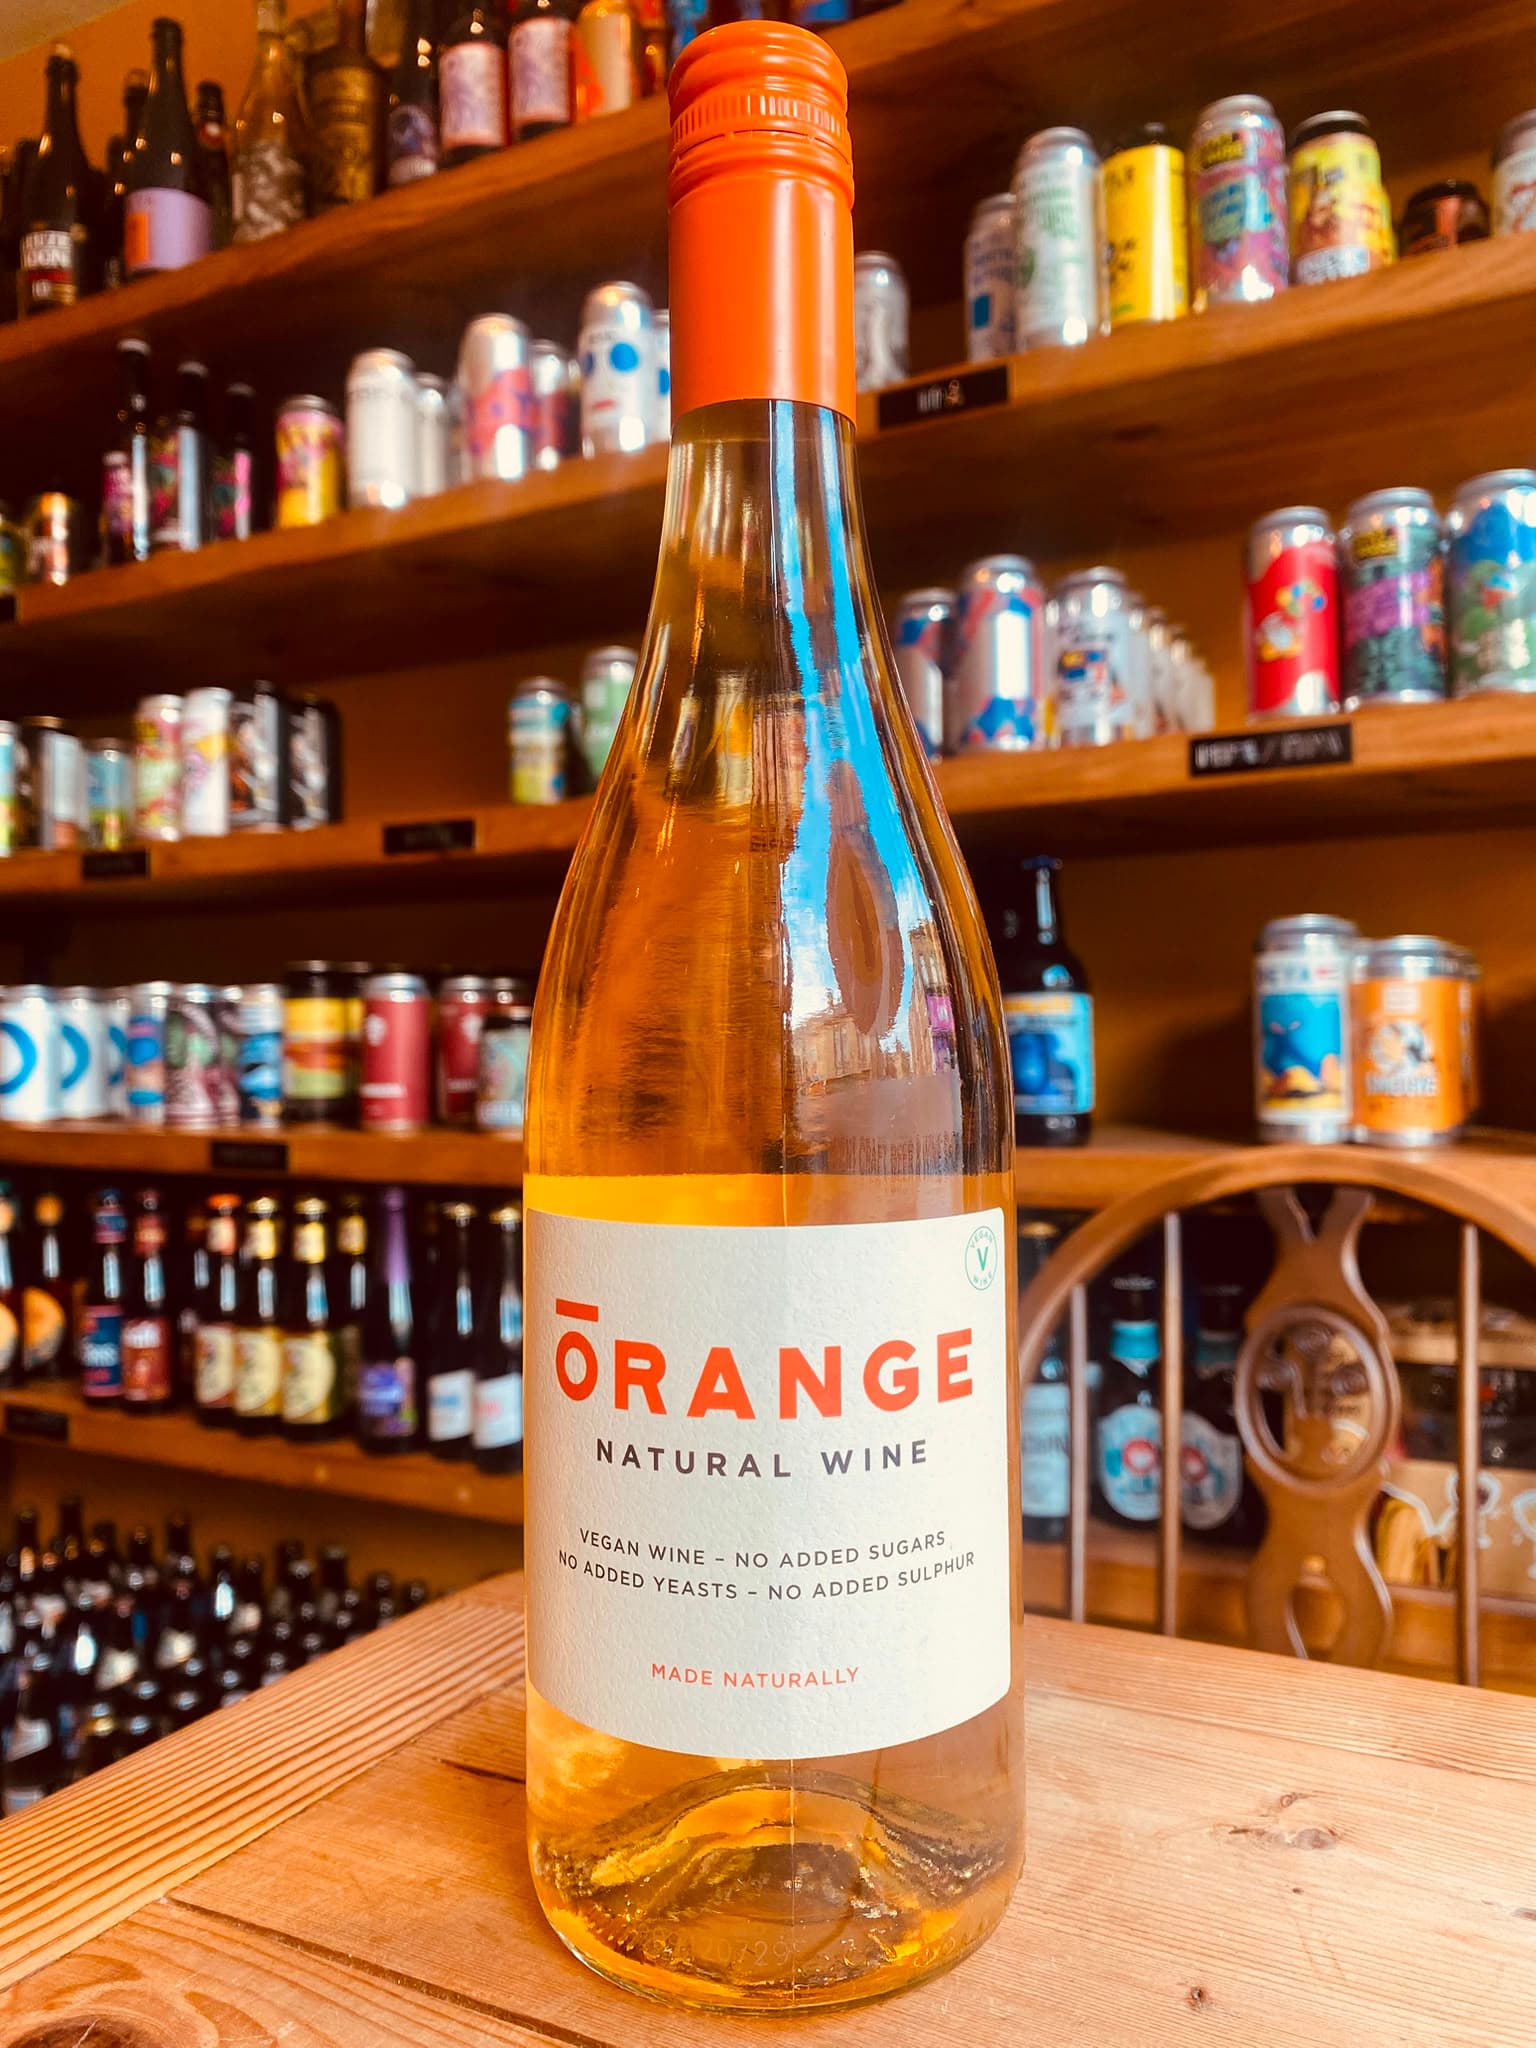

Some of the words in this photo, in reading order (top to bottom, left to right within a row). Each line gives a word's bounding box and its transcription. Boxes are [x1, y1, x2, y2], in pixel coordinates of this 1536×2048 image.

[969, 1229, 993, 1248] VEGAN
[976, 1246, 989, 1271] V
[596, 1437, 792, 1479] NATURAL
[820, 1439, 928, 1477] WINE
[579, 1527, 640, 1558] VEGAN
[648, 1543, 705, 1567] WINE
[735, 1551, 769, 1569] NO
[779, 1547, 859, 1569] ADDED
[868, 1530, 946, 1561] SUGARS
[558, 1549, 579, 1571] NO
[583, 1560, 646, 1590] ADDED
[652, 1575, 738, 1600] YEASTS
[768, 1584, 802, 1601] NO
[812, 1574, 890, 1599] ADDED
[897, 1551, 975, 1588] SULPHUR
[651, 1663, 713, 1688] MADE
[723, 1666, 860, 1689] NATURALLY
